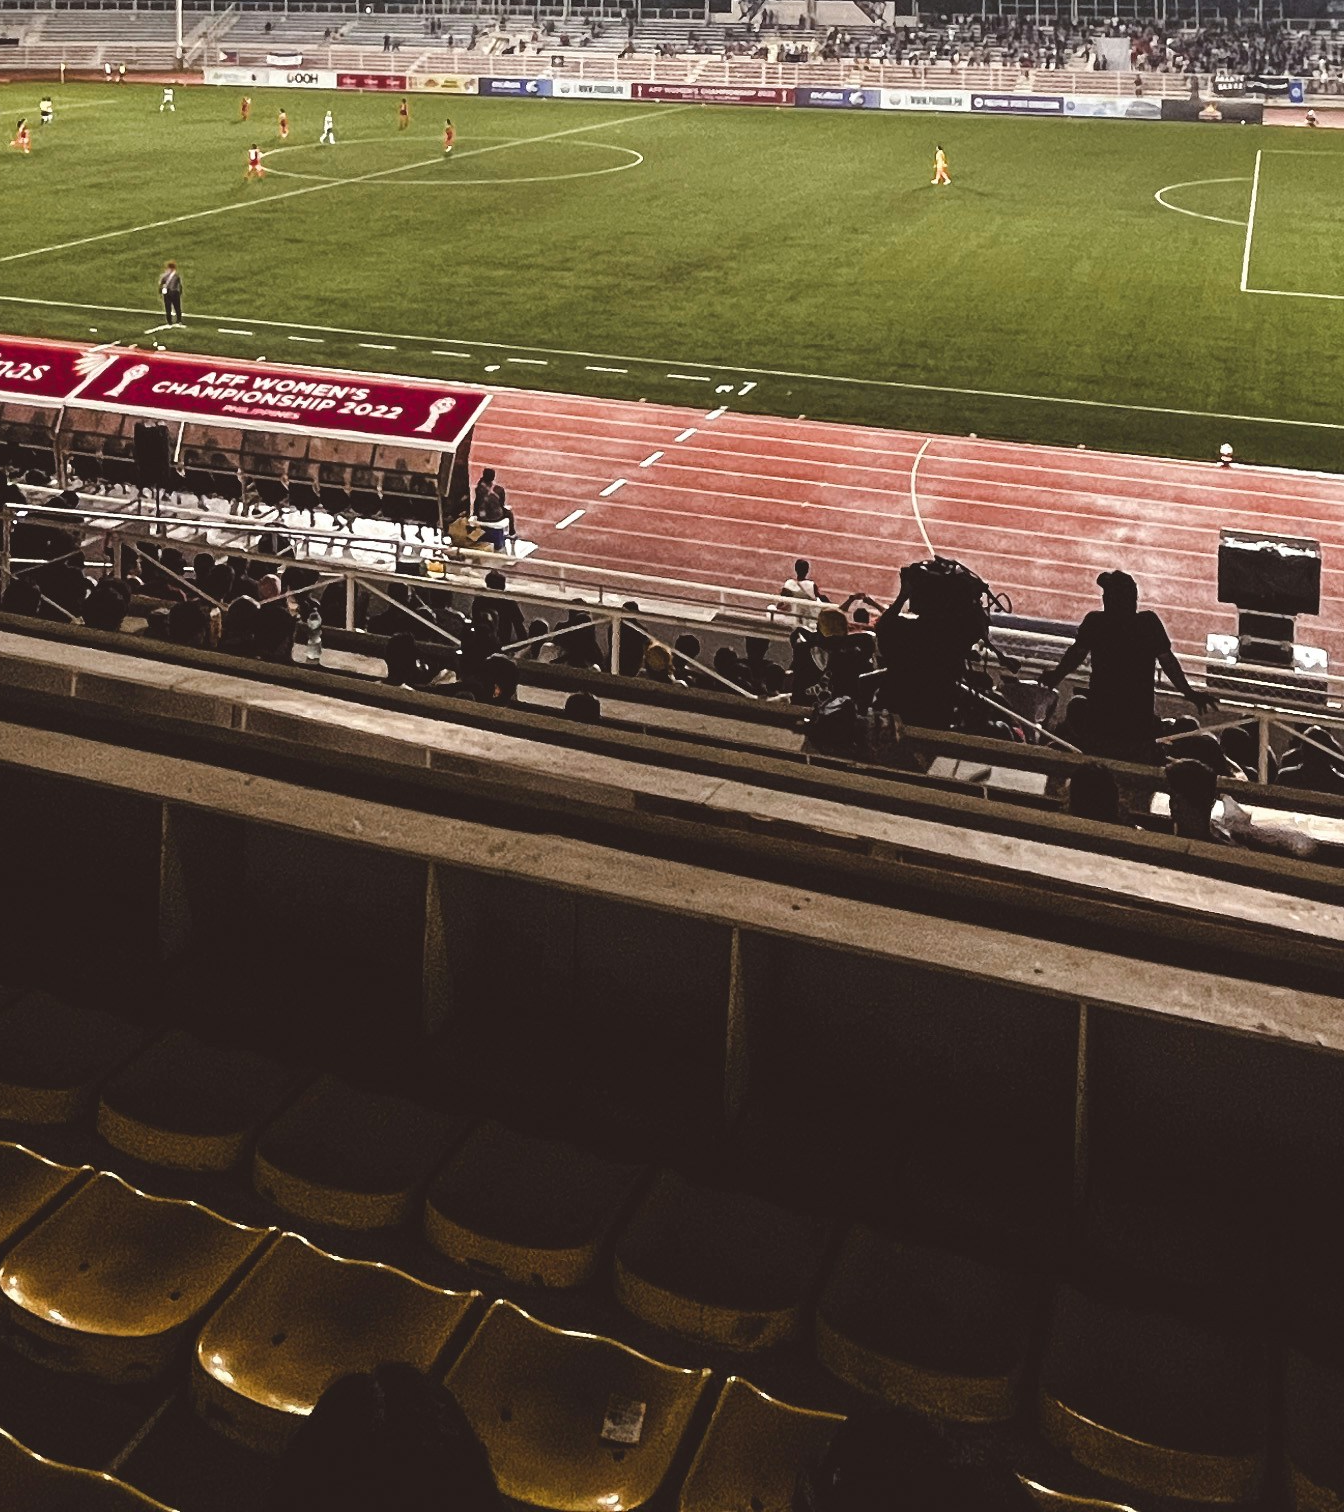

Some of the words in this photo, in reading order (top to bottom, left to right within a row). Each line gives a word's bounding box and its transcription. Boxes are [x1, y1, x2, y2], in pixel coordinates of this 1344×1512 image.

[151, 381, 335, 411] CHAMPIONSHIP
[336, 402, 404, 420] 2022
[197, 371, 250, 386] AFF
[254, 375, 371, 400] WOMEN'S
